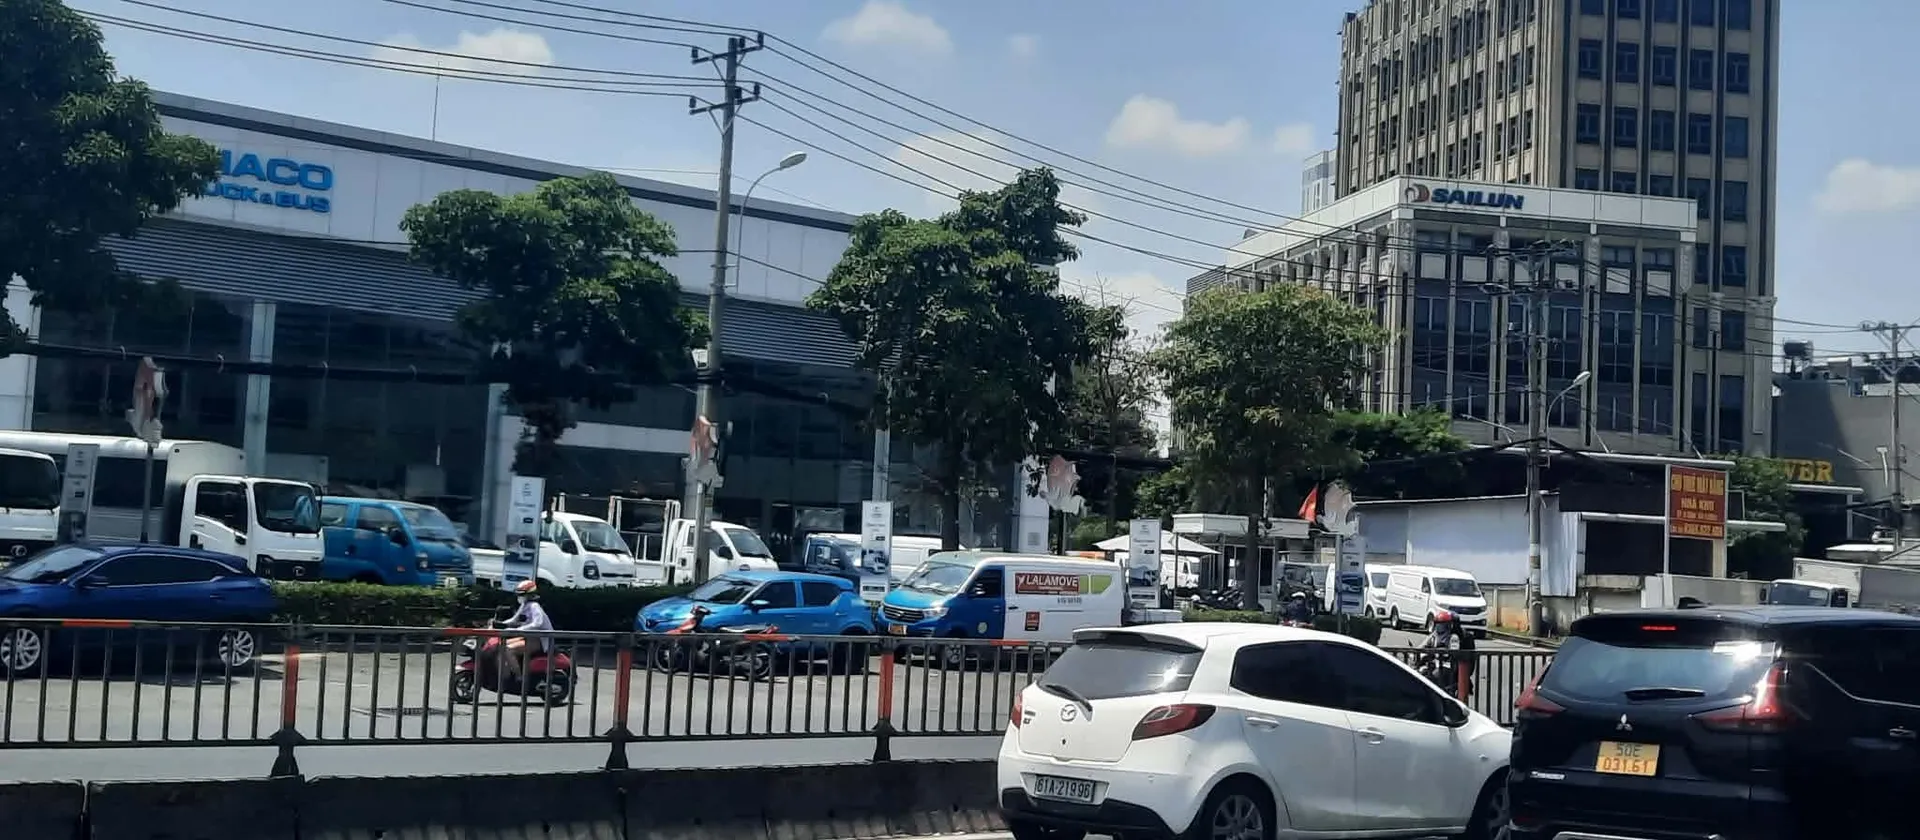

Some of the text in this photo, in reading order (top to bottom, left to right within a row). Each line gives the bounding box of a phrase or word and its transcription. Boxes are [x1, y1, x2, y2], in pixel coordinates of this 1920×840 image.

[1431, 188, 1524, 210] SAILUN
[1026, 575, 1078, 587] LALAMOVE
[1616, 743, 1643, 757] 50E
